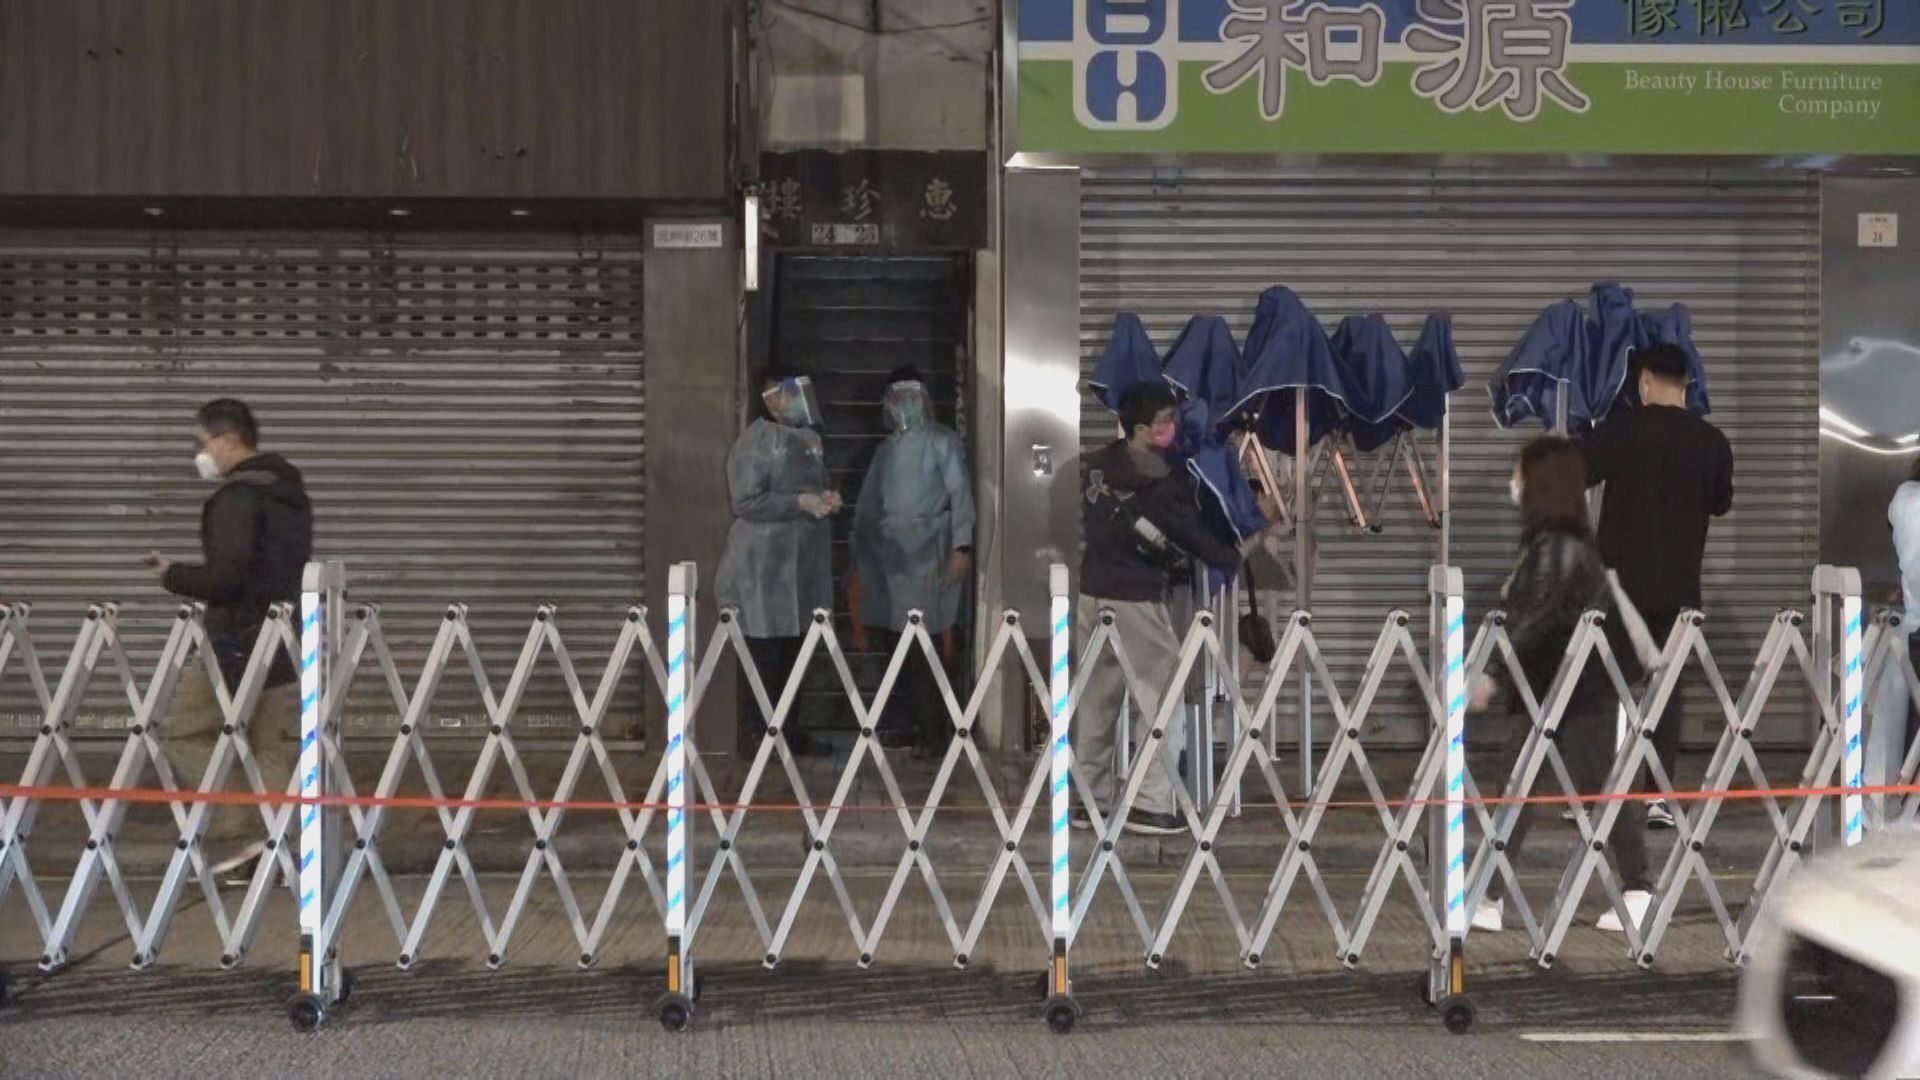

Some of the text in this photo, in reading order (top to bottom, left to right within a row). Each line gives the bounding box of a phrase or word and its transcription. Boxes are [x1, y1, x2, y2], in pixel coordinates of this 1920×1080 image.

[1202, 0, 1590, 123] 和源
[1625, 70, 1883, 95] Beauty House Furniture
[1779, 95, 1881, 119] Company
